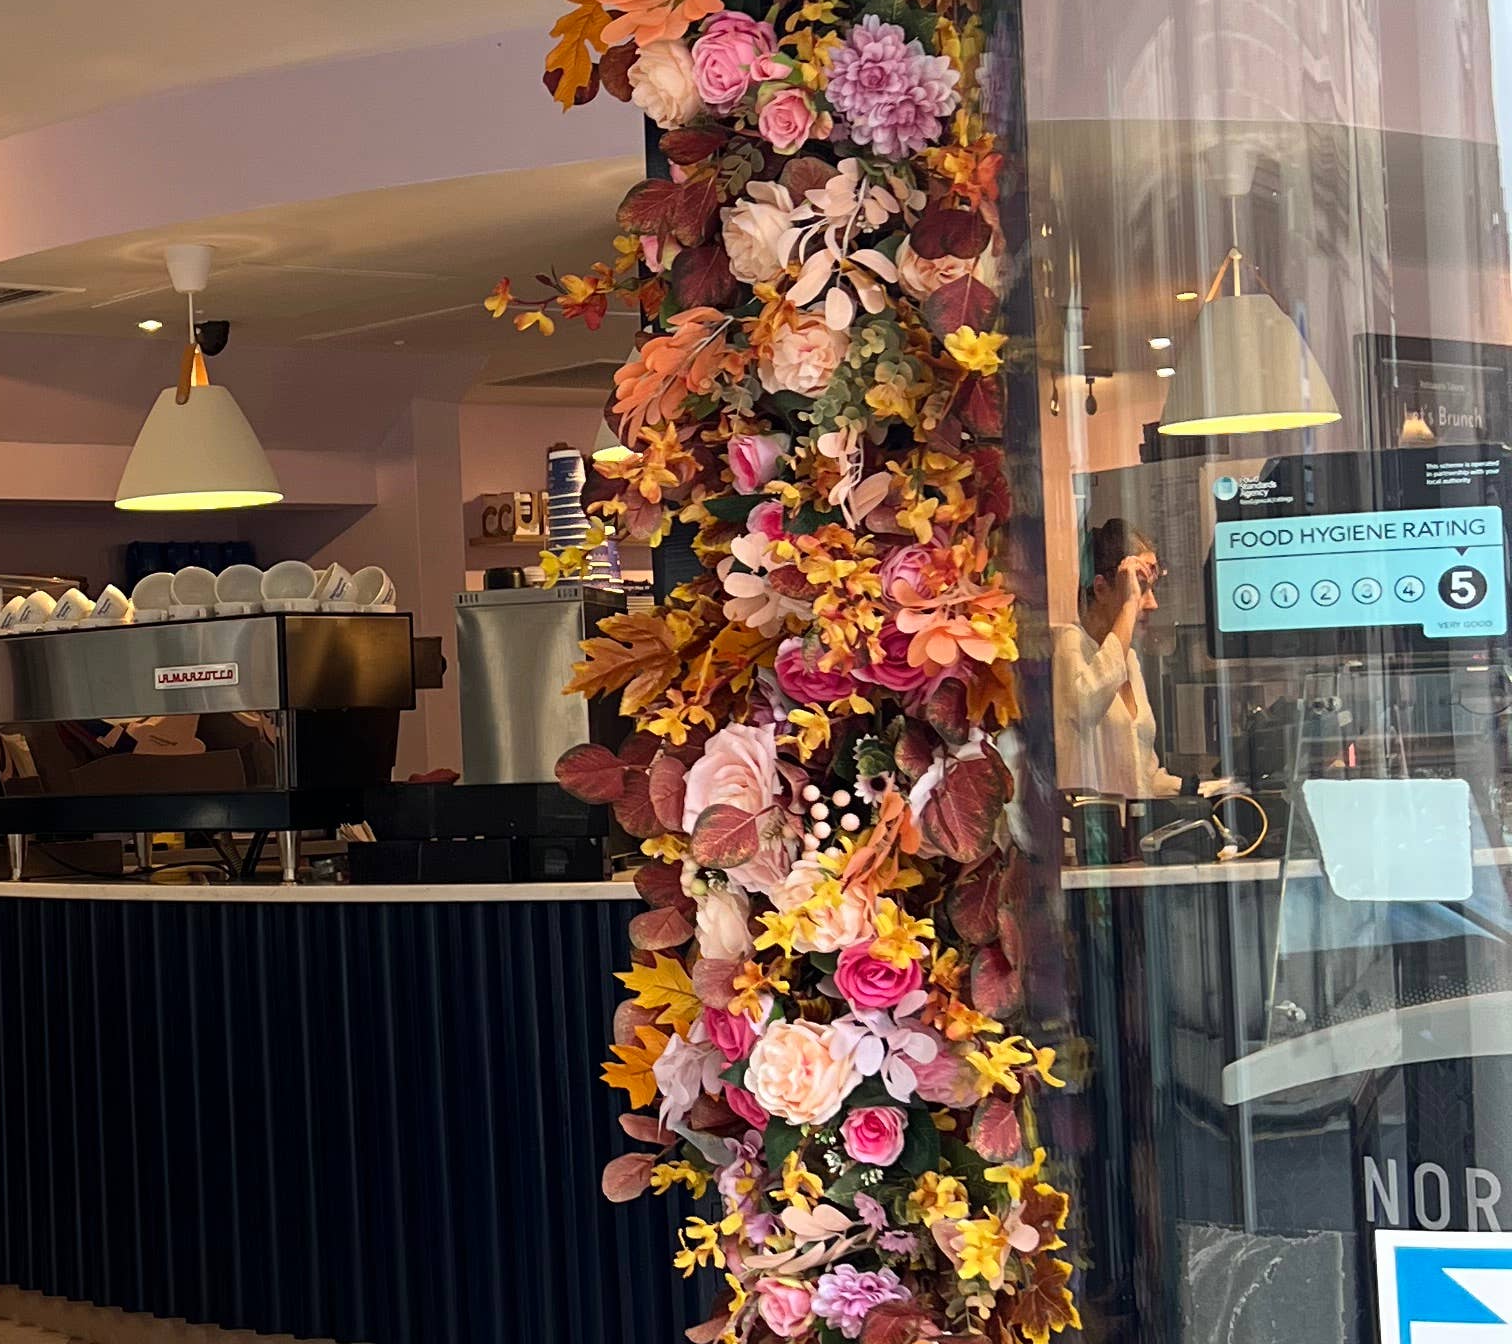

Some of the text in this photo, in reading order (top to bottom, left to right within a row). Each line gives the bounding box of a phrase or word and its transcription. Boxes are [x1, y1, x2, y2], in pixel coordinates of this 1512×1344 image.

[1438, 405, 1483, 429] Brunch
[1229, 518, 1486, 549] FOOD HYGIENE RATING
[1240, 571, 1477, 606] 0 1 2 3 4 5
